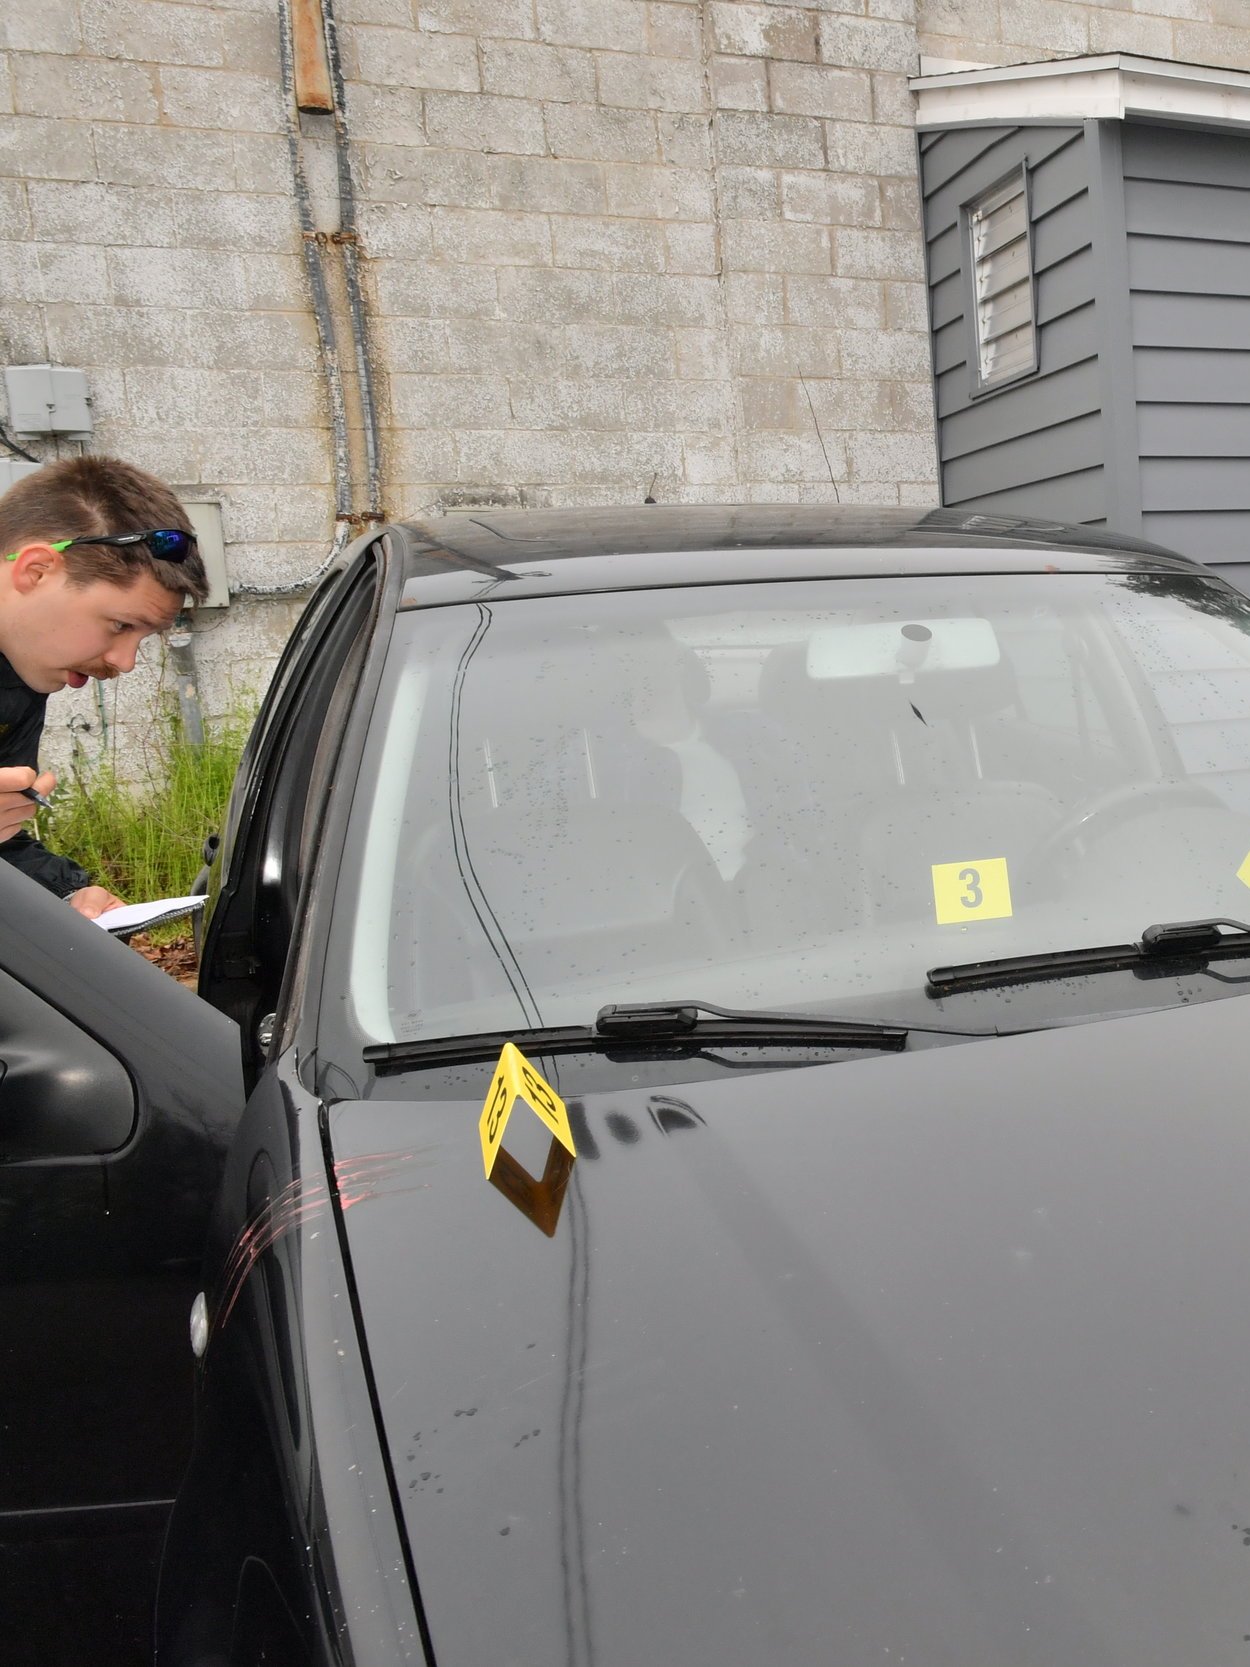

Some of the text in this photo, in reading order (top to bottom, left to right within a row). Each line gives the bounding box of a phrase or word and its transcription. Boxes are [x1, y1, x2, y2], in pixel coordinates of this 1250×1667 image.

[958, 867, 983, 908] 3
[486, 1075, 508, 1145] 13
[521, 1066, 559, 1125] 13
